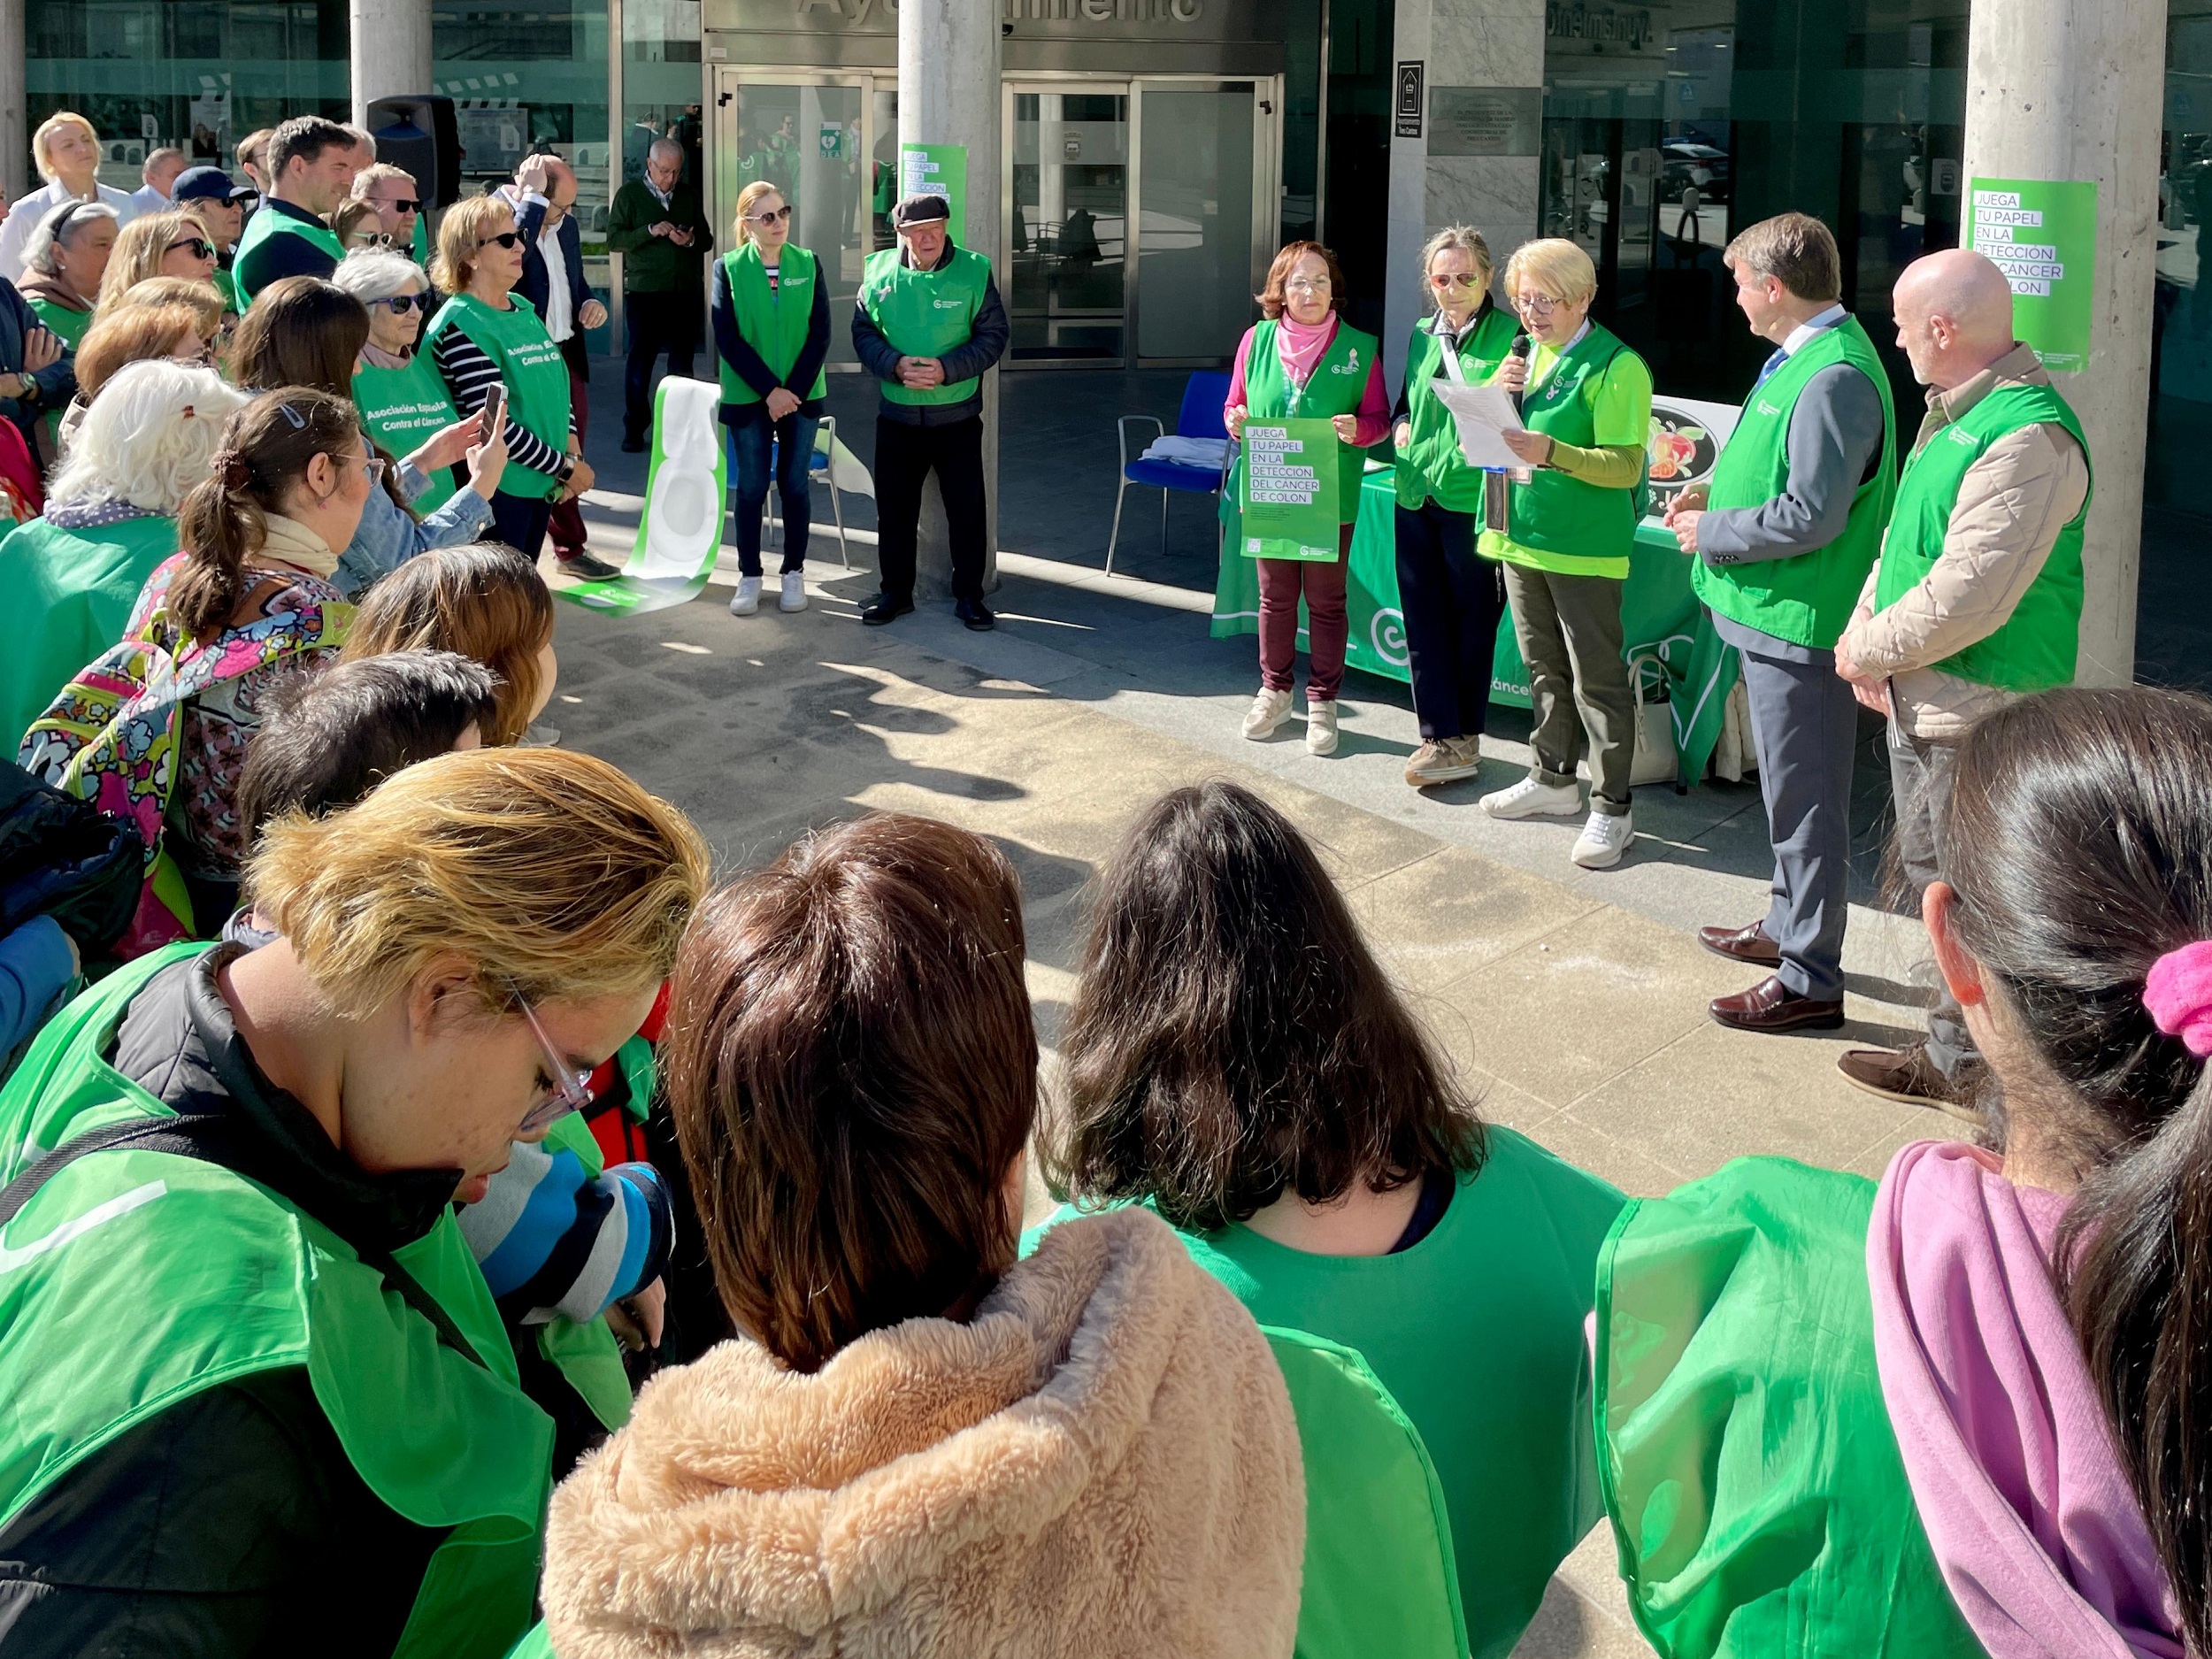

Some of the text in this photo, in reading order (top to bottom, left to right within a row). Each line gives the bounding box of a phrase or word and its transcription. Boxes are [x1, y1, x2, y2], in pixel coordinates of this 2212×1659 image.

[1978, 193, 2017, 206] JUEGA
[1977, 210, 2039, 225] TU PAPEL
[1976, 227, 2010, 241] EN LA
[1975, 243, 2053, 260] DETECCIÓN
[1999, 260, 2062, 278] CÁNCER
[2010, 280, 2041, 294] LON
[366, 404, 417, 420] Asociación
[382, 419, 412, 432] Contra
[413, 418, 420, 427] el
[1250, 428, 1285, 438] JUEGA
[1252, 441, 1302, 451] TU PAPEL
[1252, 454, 1282, 463] EN LA
[1252, 466, 1312, 477] DETECCIÓN
[1252, 479, 1318, 490] DEL CÁNCER
[1253, 492, 1307, 503] DE COLON
[1490, 677, 1532, 696] ánce
